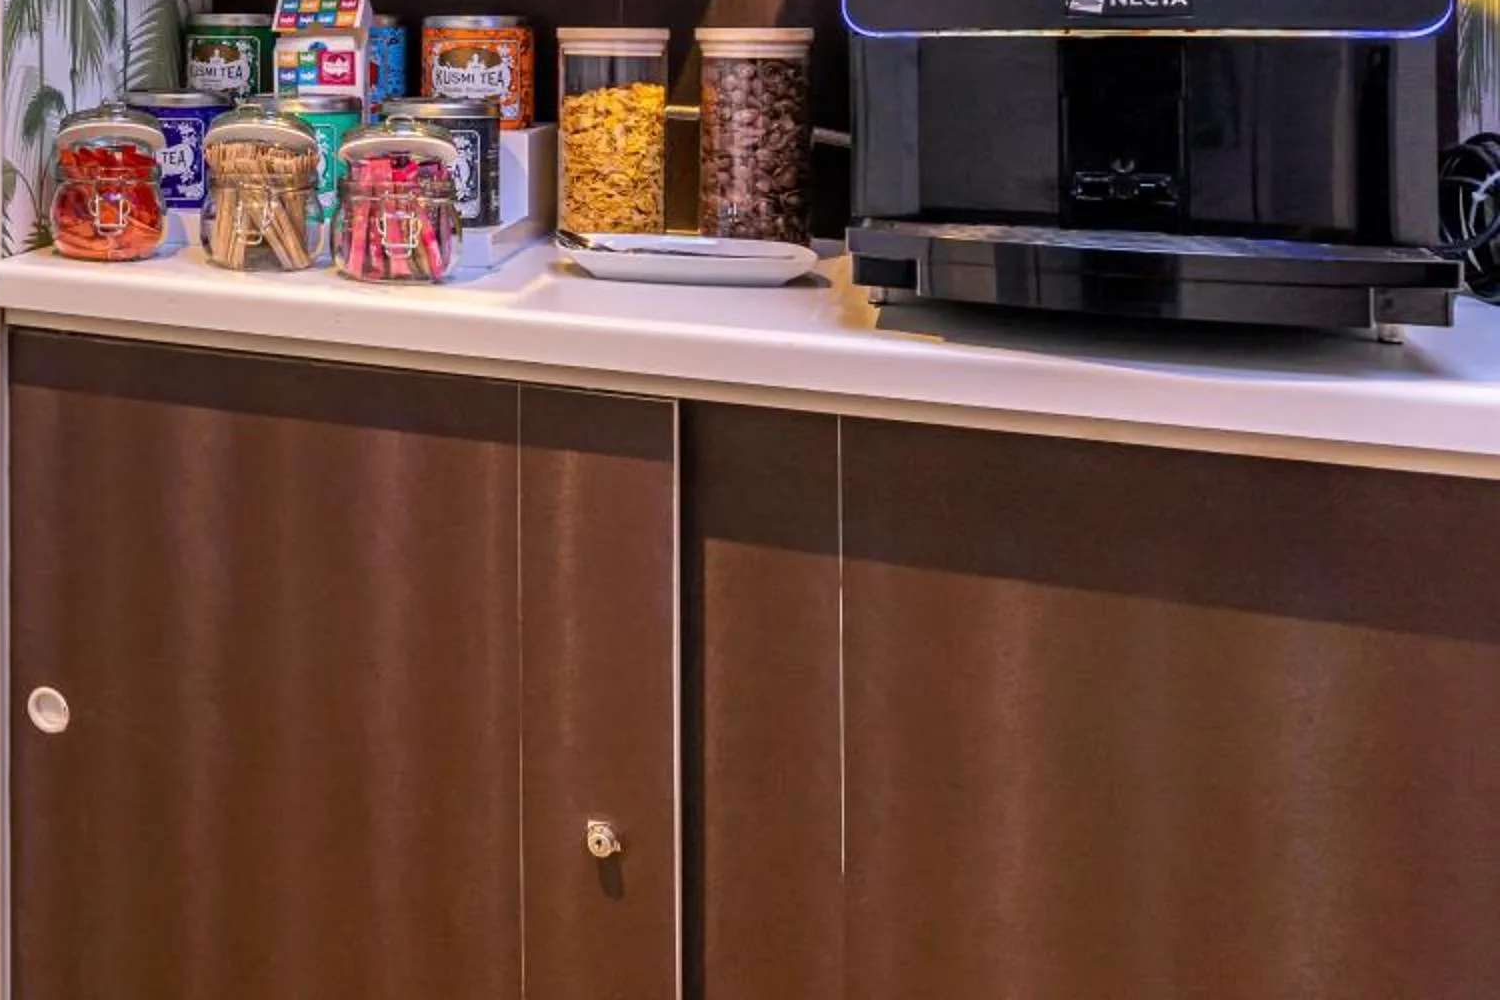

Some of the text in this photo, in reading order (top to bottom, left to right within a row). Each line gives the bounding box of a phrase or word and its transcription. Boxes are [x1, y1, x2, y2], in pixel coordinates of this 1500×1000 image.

[188, 64, 243, 79] USMI TEA
[435, 69, 505, 87] KUSMI TEA
[162, 149, 187, 168] TEA
